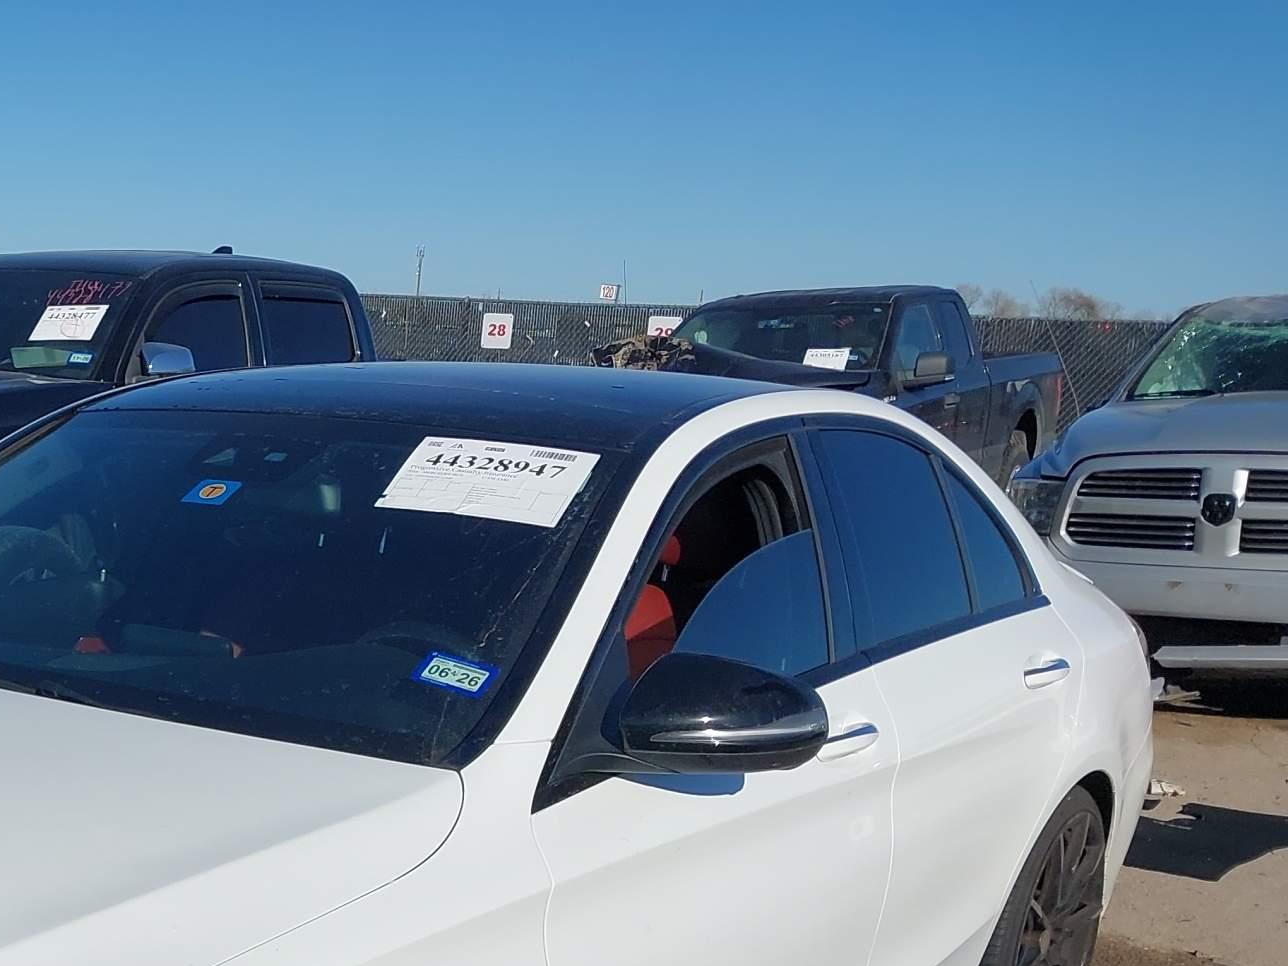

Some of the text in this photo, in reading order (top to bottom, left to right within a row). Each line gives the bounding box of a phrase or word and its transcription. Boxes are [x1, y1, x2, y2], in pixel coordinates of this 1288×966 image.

[487, 323, 507, 337] 28
[425, 453, 568, 479] 44328947
[427, 664, 451, 678] 06
[455, 672, 481, 687] 26
